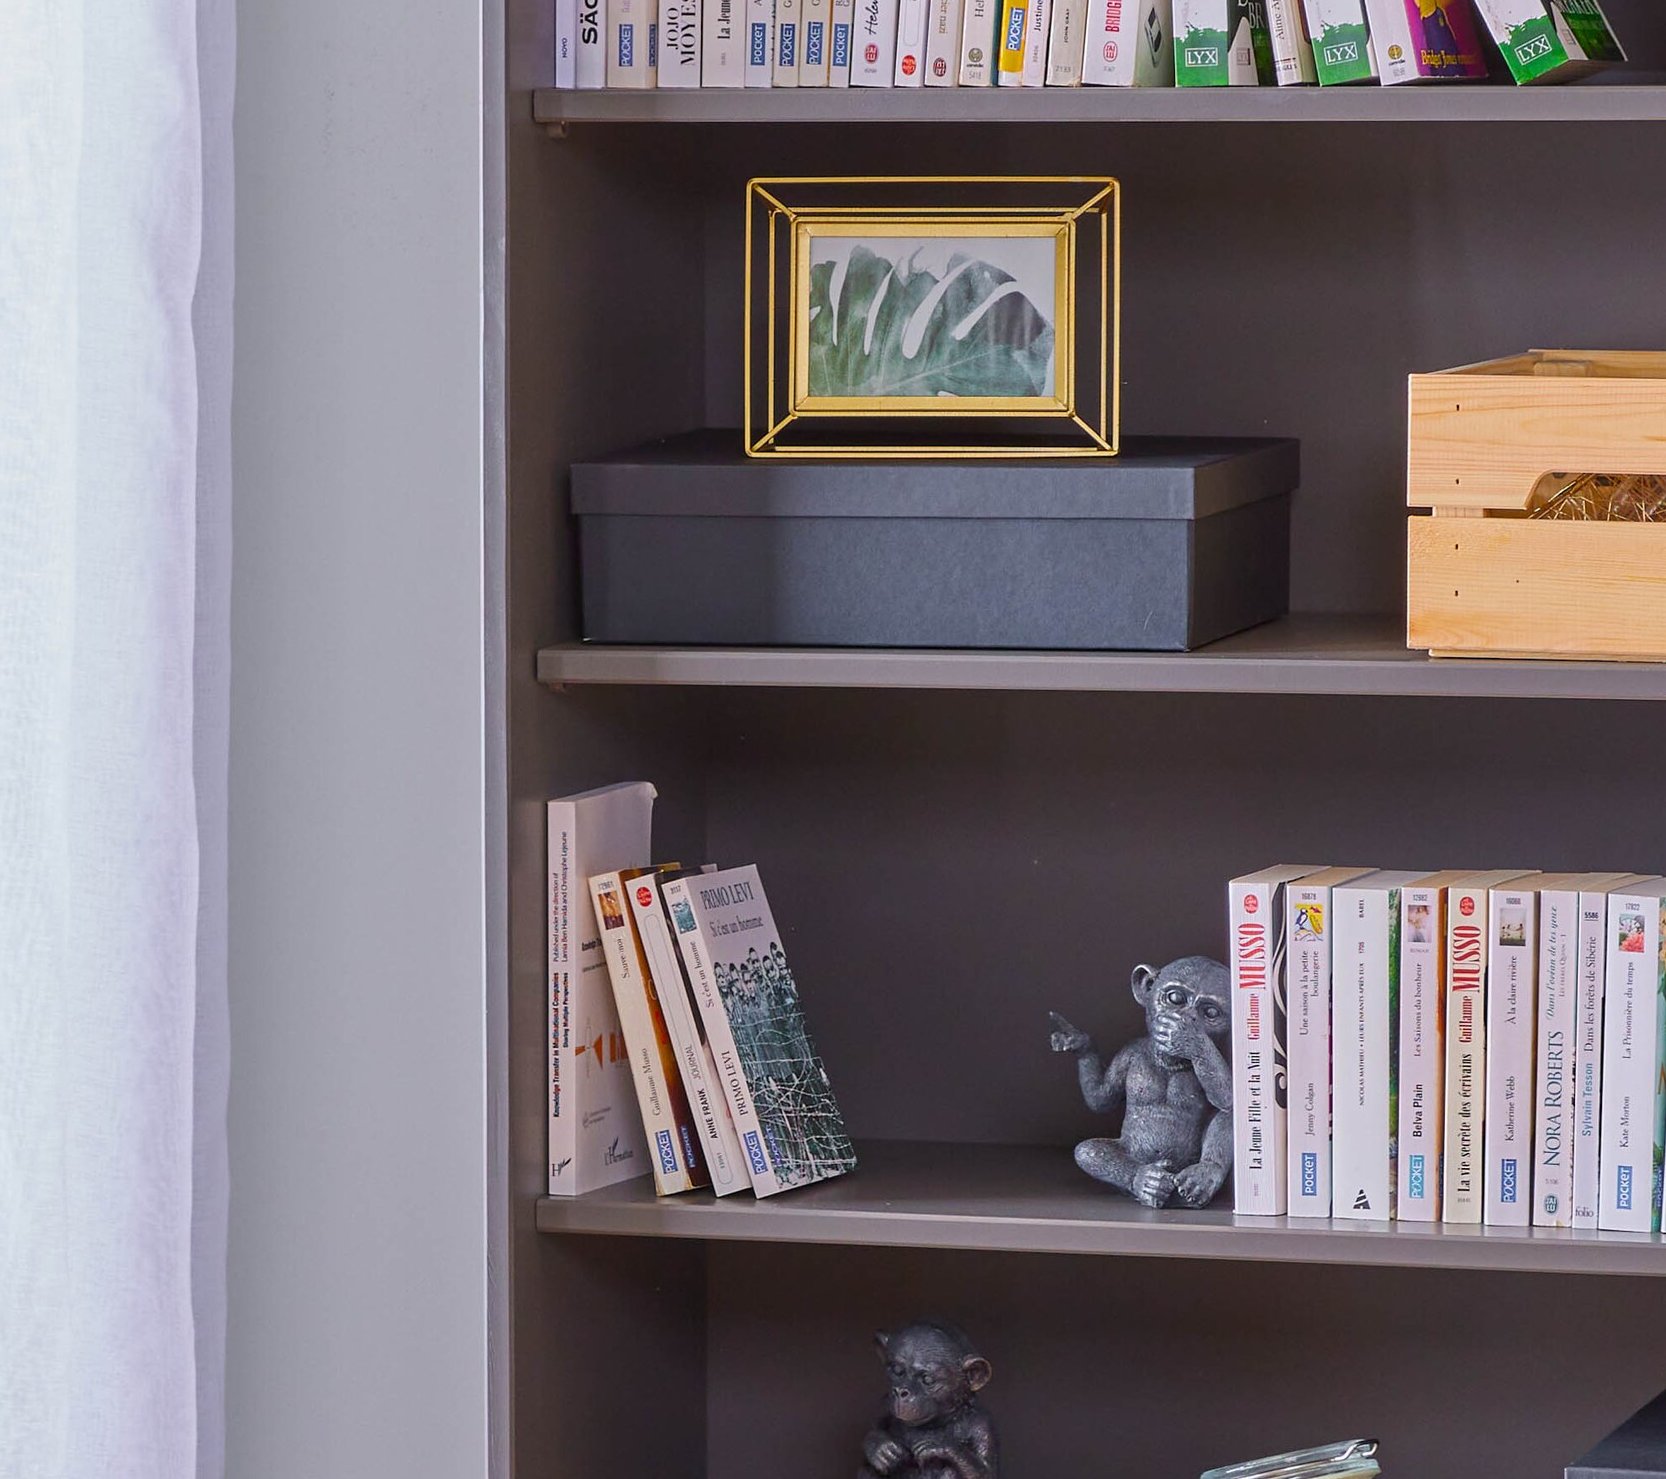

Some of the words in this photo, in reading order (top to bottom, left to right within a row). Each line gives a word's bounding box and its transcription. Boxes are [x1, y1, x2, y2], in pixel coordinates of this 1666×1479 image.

[620, 25, 632, 66] POCKET
[667, 7, 679, 50] JOJO
[717, 28, 730, 40] La
[782, 24, 793, 66] POCKET
[809, 22, 821, 63] POCKET
[1008, 8, 1023, 50] POCKET
[1187, 51, 1216, 63] LYX
[1326, 45, 1357, 63] LYX
[1518, 38, 1550, 62] LYX
[700, 886, 729, 910] PRIMO
[728, 881, 754, 904] LEVI
[1238, 923, 1266, 989] MUSSO
[1452, 925, 1481, 993] MUSSO
[1247, 993, 1260, 1040] Guillaume
[1459, 996, 1472, 1043] Guillaume
[685, 1045, 700, 1080] JOURNAL
[721, 1051, 736, 1077] LEVI
[1248, 1052, 1260, 1069] Nuit
[1459, 1053, 1472, 1098] écrivains
[1545, 1031, 1564, 1107] ROBERTS
[1248, 1074, 1260, 1083] la
[1249, 1087, 1261, 1096] et
[1584, 1063, 1592, 1097] Tesson
[697, 1088, 712, 1115] FRANK
[730, 1078, 748, 1116] PRIMO
[1248, 1101, 1261, 1122] Fille
[1413, 1084, 1423, 1108] Plain
[1459, 1102, 1472, 1118] des
[706, 1116, 718, 1139] ANNE
[1413, 1111, 1422, 1137] Belva
[1582, 1100, 1593, 1136] Sylvain
[657, 1131, 676, 1173] POCKET
[746, 1133, 766, 1173] POCKET
[1249, 1127, 1262, 1154] Jeune
[1458, 1124, 1471, 1158] secrète
[1543, 1113, 1561, 1166] NORA
[1249, 1158, 1262, 1169] La
[1411, 1156, 1423, 1198] POCKET
[1460, 1161, 1470, 1175] vie
[1458, 1179, 1470, 1192] La
[1503, 1160, 1516, 1202] POCKET
